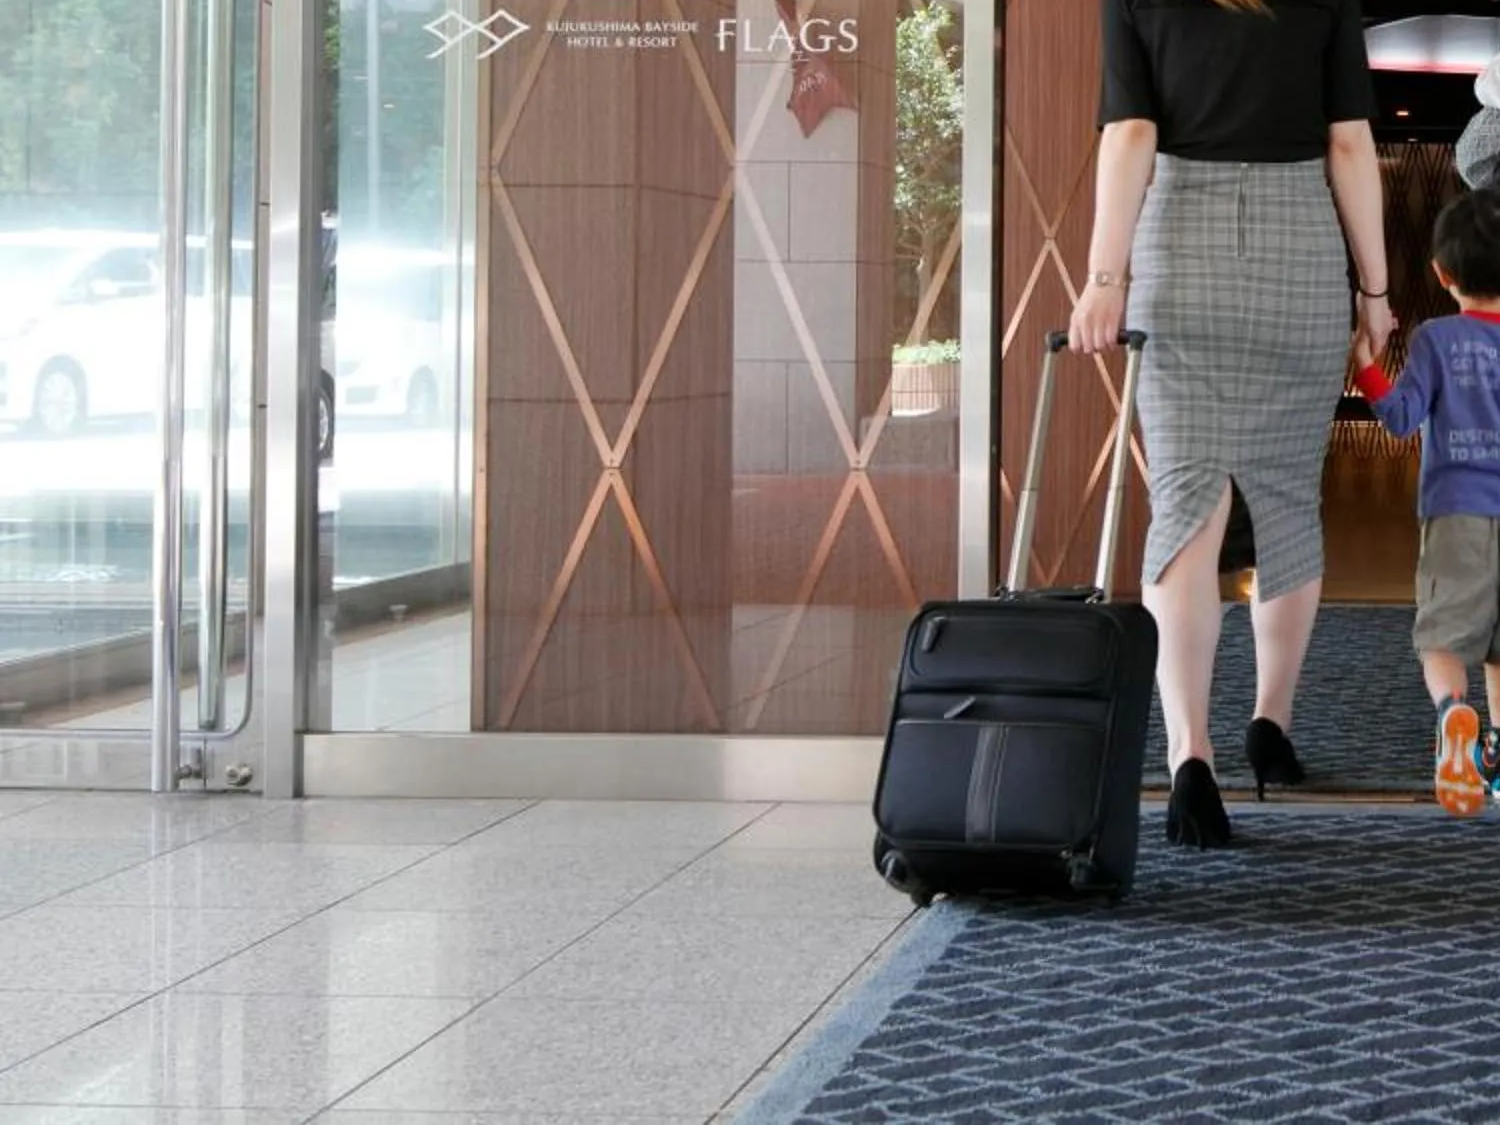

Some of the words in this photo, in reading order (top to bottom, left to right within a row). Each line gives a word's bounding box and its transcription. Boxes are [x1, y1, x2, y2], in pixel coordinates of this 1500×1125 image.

[645, 20, 699, 33] BAYSIDE
[566, 36, 609, 48] HOTEL
[628, 36, 678, 48] RESORT
[714, 18, 859, 53] FLAGS
[1450, 447, 1469, 461] TO
